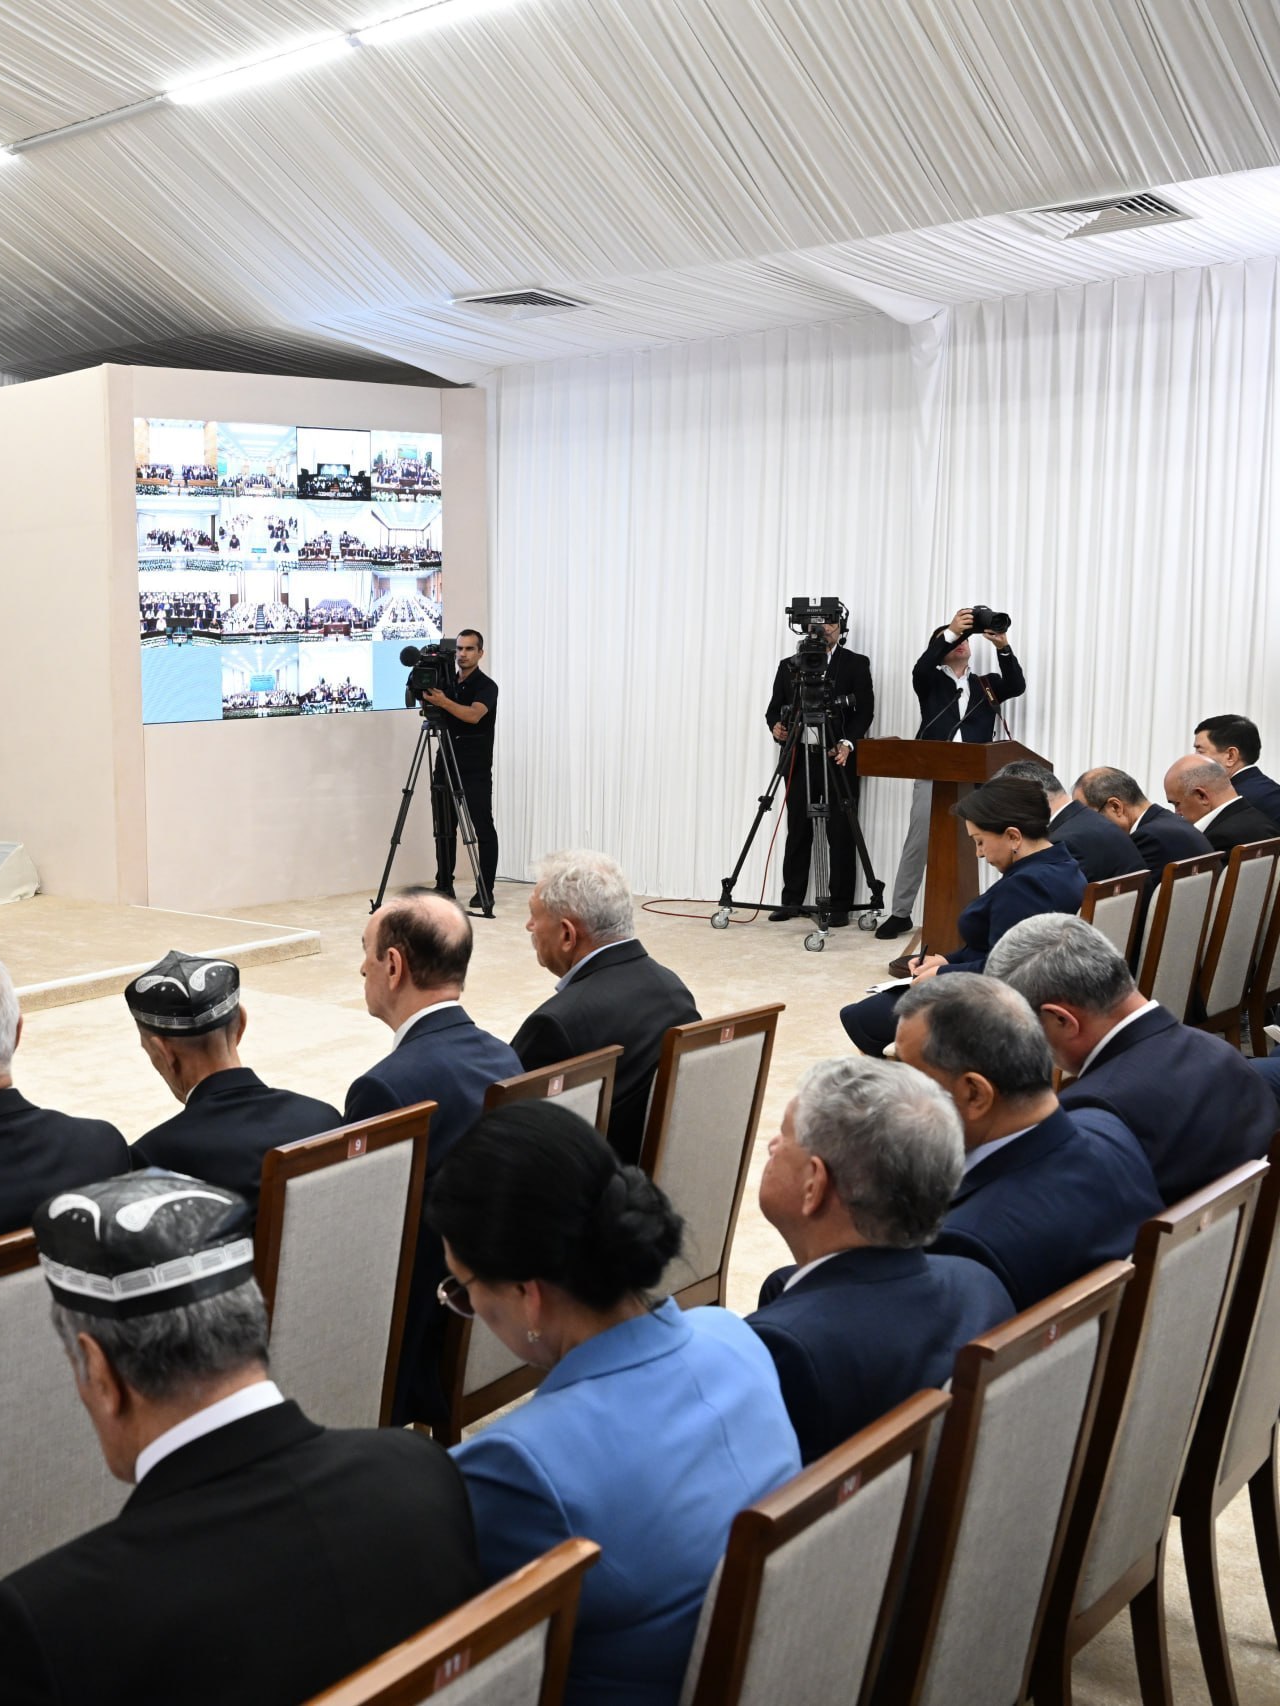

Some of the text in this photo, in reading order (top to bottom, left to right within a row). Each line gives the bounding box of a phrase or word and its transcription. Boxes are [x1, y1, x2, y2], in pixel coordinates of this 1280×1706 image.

[812, 597, 817, 605] 1
[355, 1138, 362, 1151] 9
[444, 1653, 461, 1678] 11
